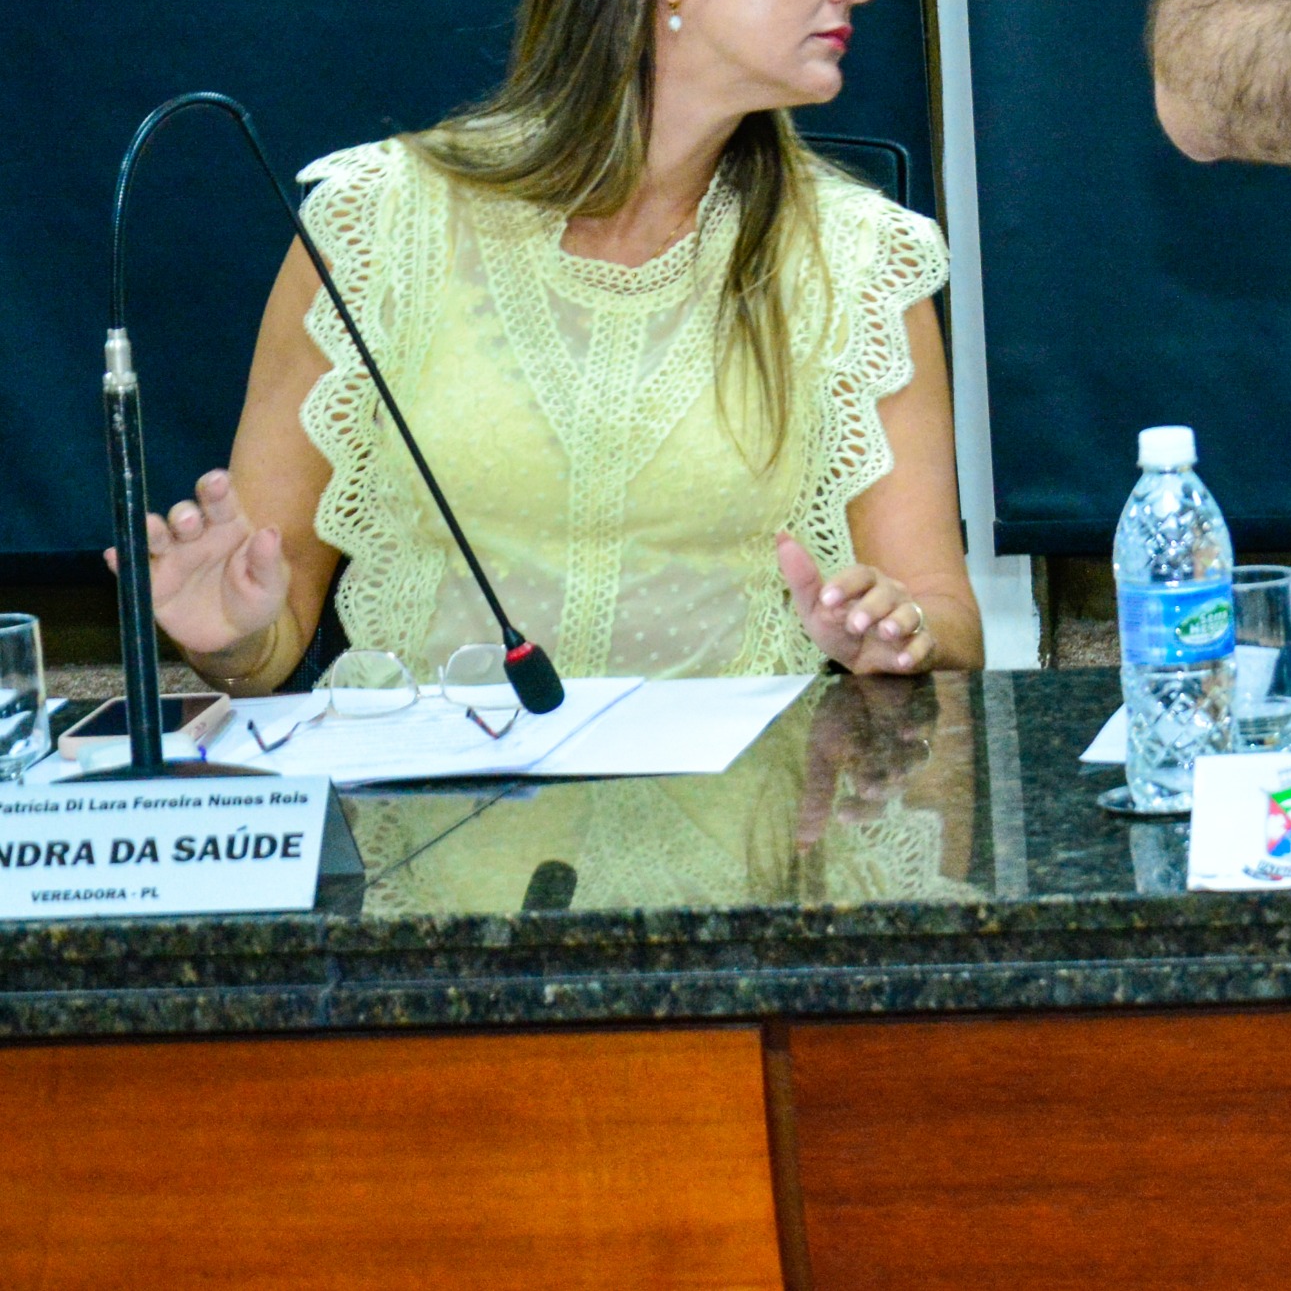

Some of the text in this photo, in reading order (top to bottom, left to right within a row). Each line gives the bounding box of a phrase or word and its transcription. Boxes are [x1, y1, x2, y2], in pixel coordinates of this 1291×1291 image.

[65, 797, 84, 812] Di
[89, 796, 128, 811] Lara
[132, 793, 202, 810] Ferreira
[208, 792, 264, 807] Nunes
[270, 790, 309, 805] Reis
[109, 837, 160, 865] DA
[171, 825, 305, 862] SAÚDE
[31, 888, 126, 903] VEREADORA
[141, 887, 160, 900] PL
